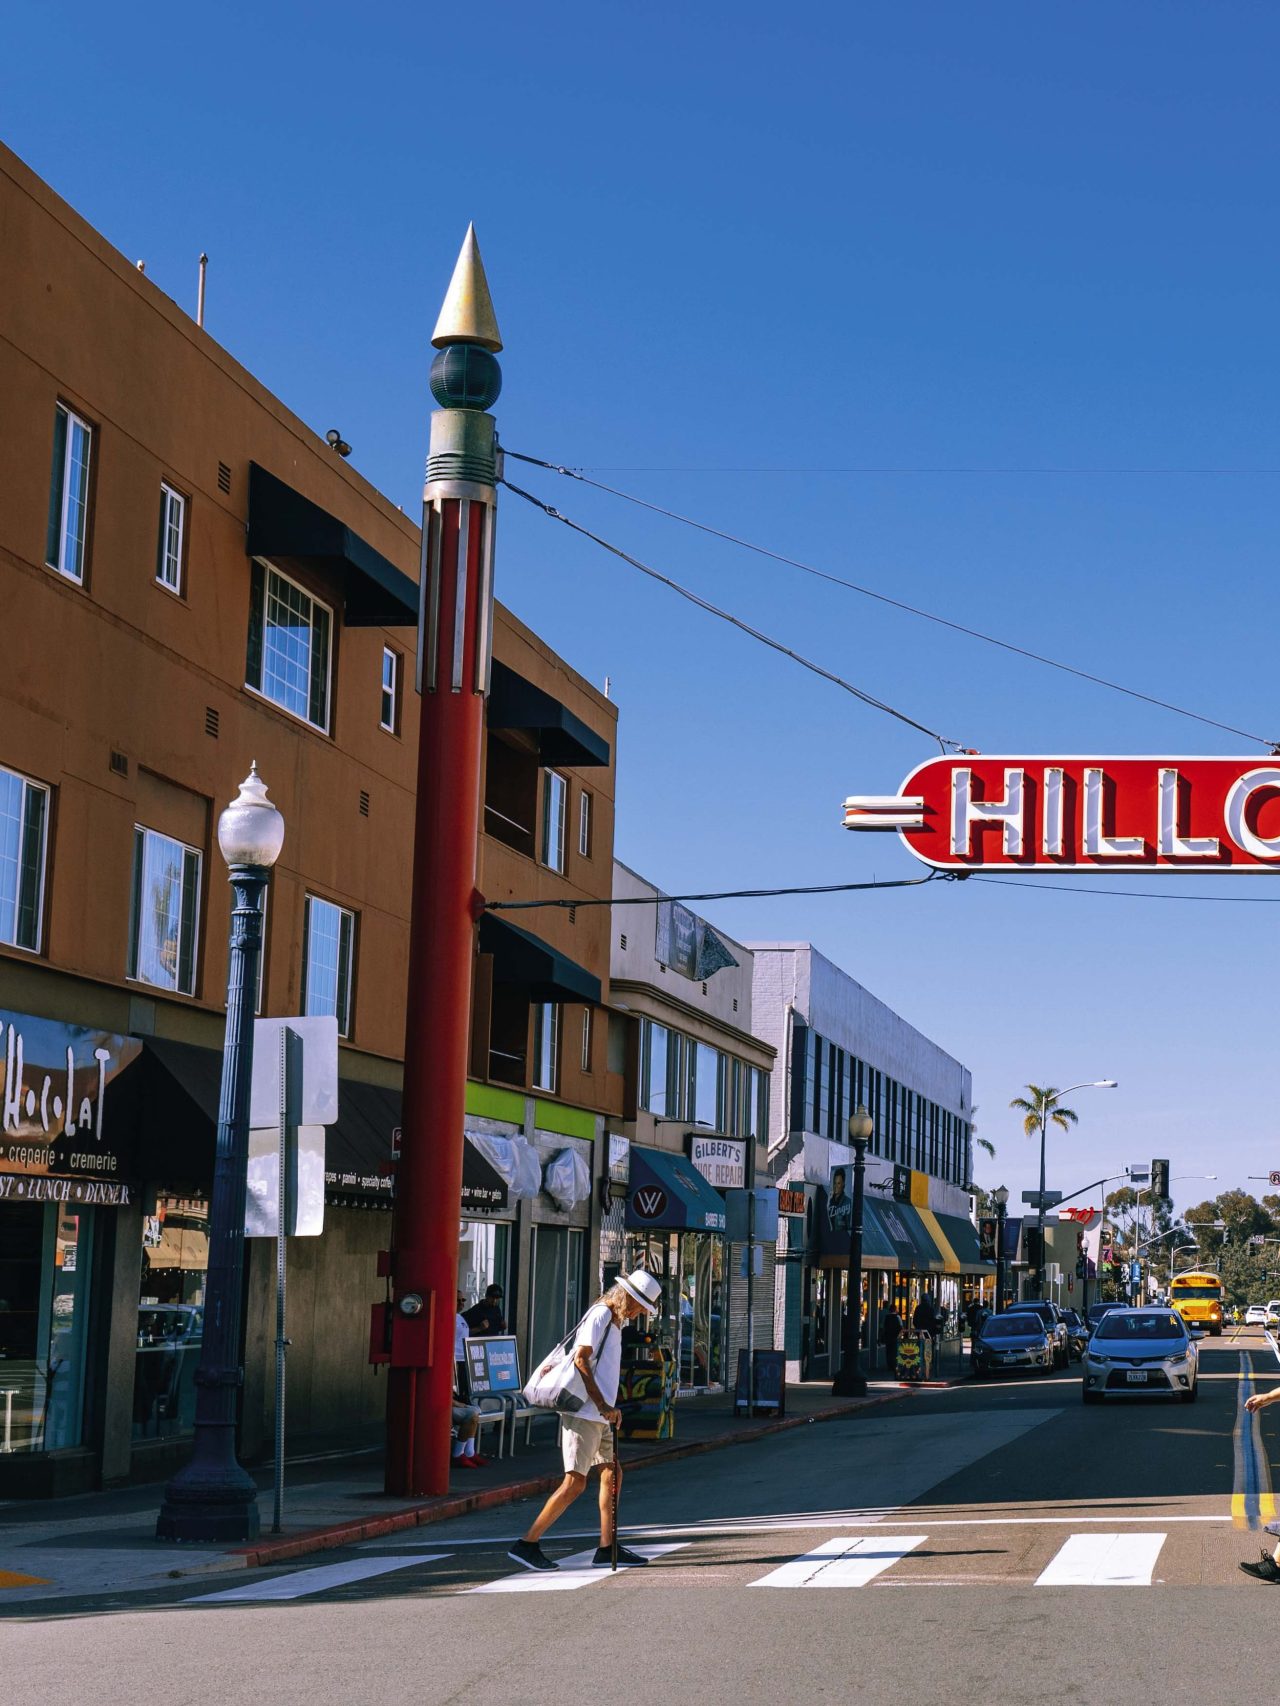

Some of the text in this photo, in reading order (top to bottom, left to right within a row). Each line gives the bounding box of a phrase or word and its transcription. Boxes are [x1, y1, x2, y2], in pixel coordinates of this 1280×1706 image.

[8, 1146, 118, 1171] creperie cremerie
[695, 1142, 742, 1163] GILBERT'S
[715, 1165, 743, 1185] REPAIR
[27, 1177, 72, 1201] LUNCH
[85, 1183, 130, 1205] DINNER
